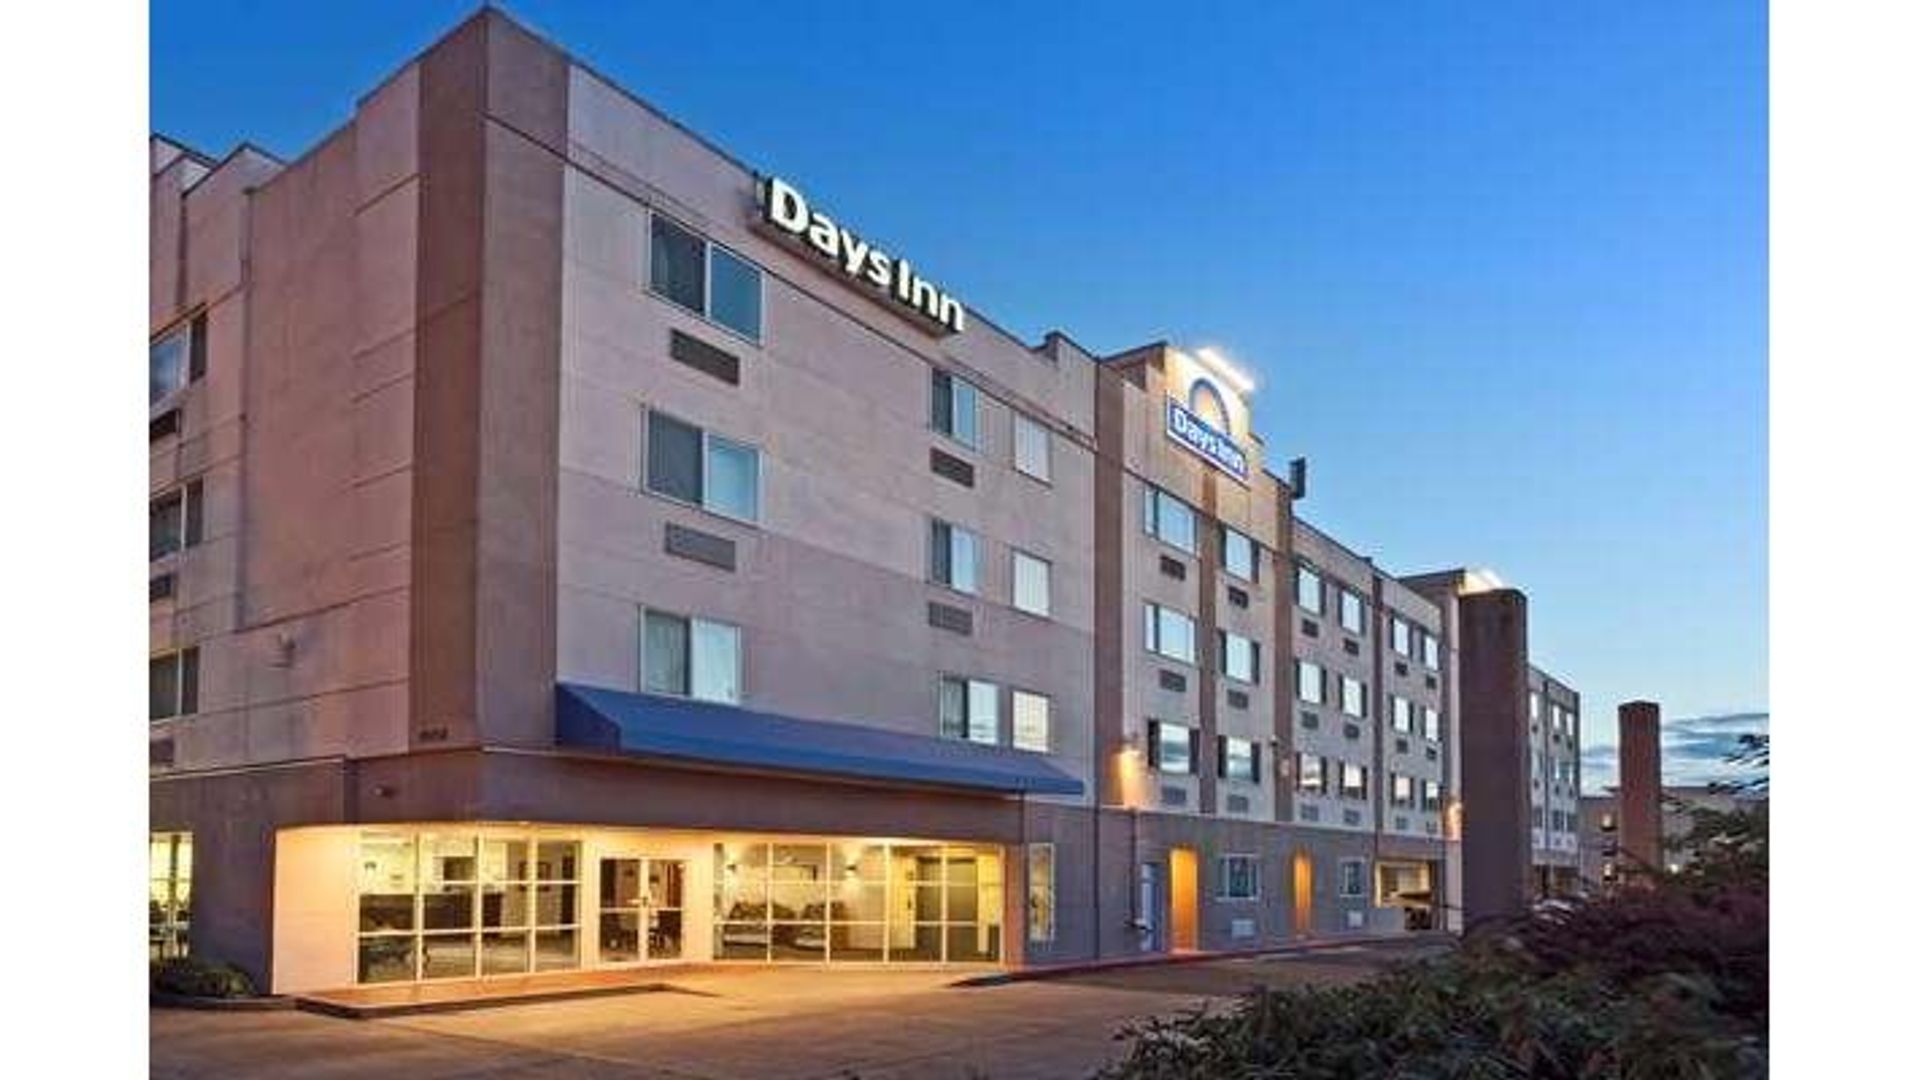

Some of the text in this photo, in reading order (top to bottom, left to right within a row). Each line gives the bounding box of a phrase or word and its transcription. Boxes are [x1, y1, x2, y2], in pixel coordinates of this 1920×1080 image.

[770, 177, 964, 331] Days Inn
[1173, 407, 1217, 453] Days
